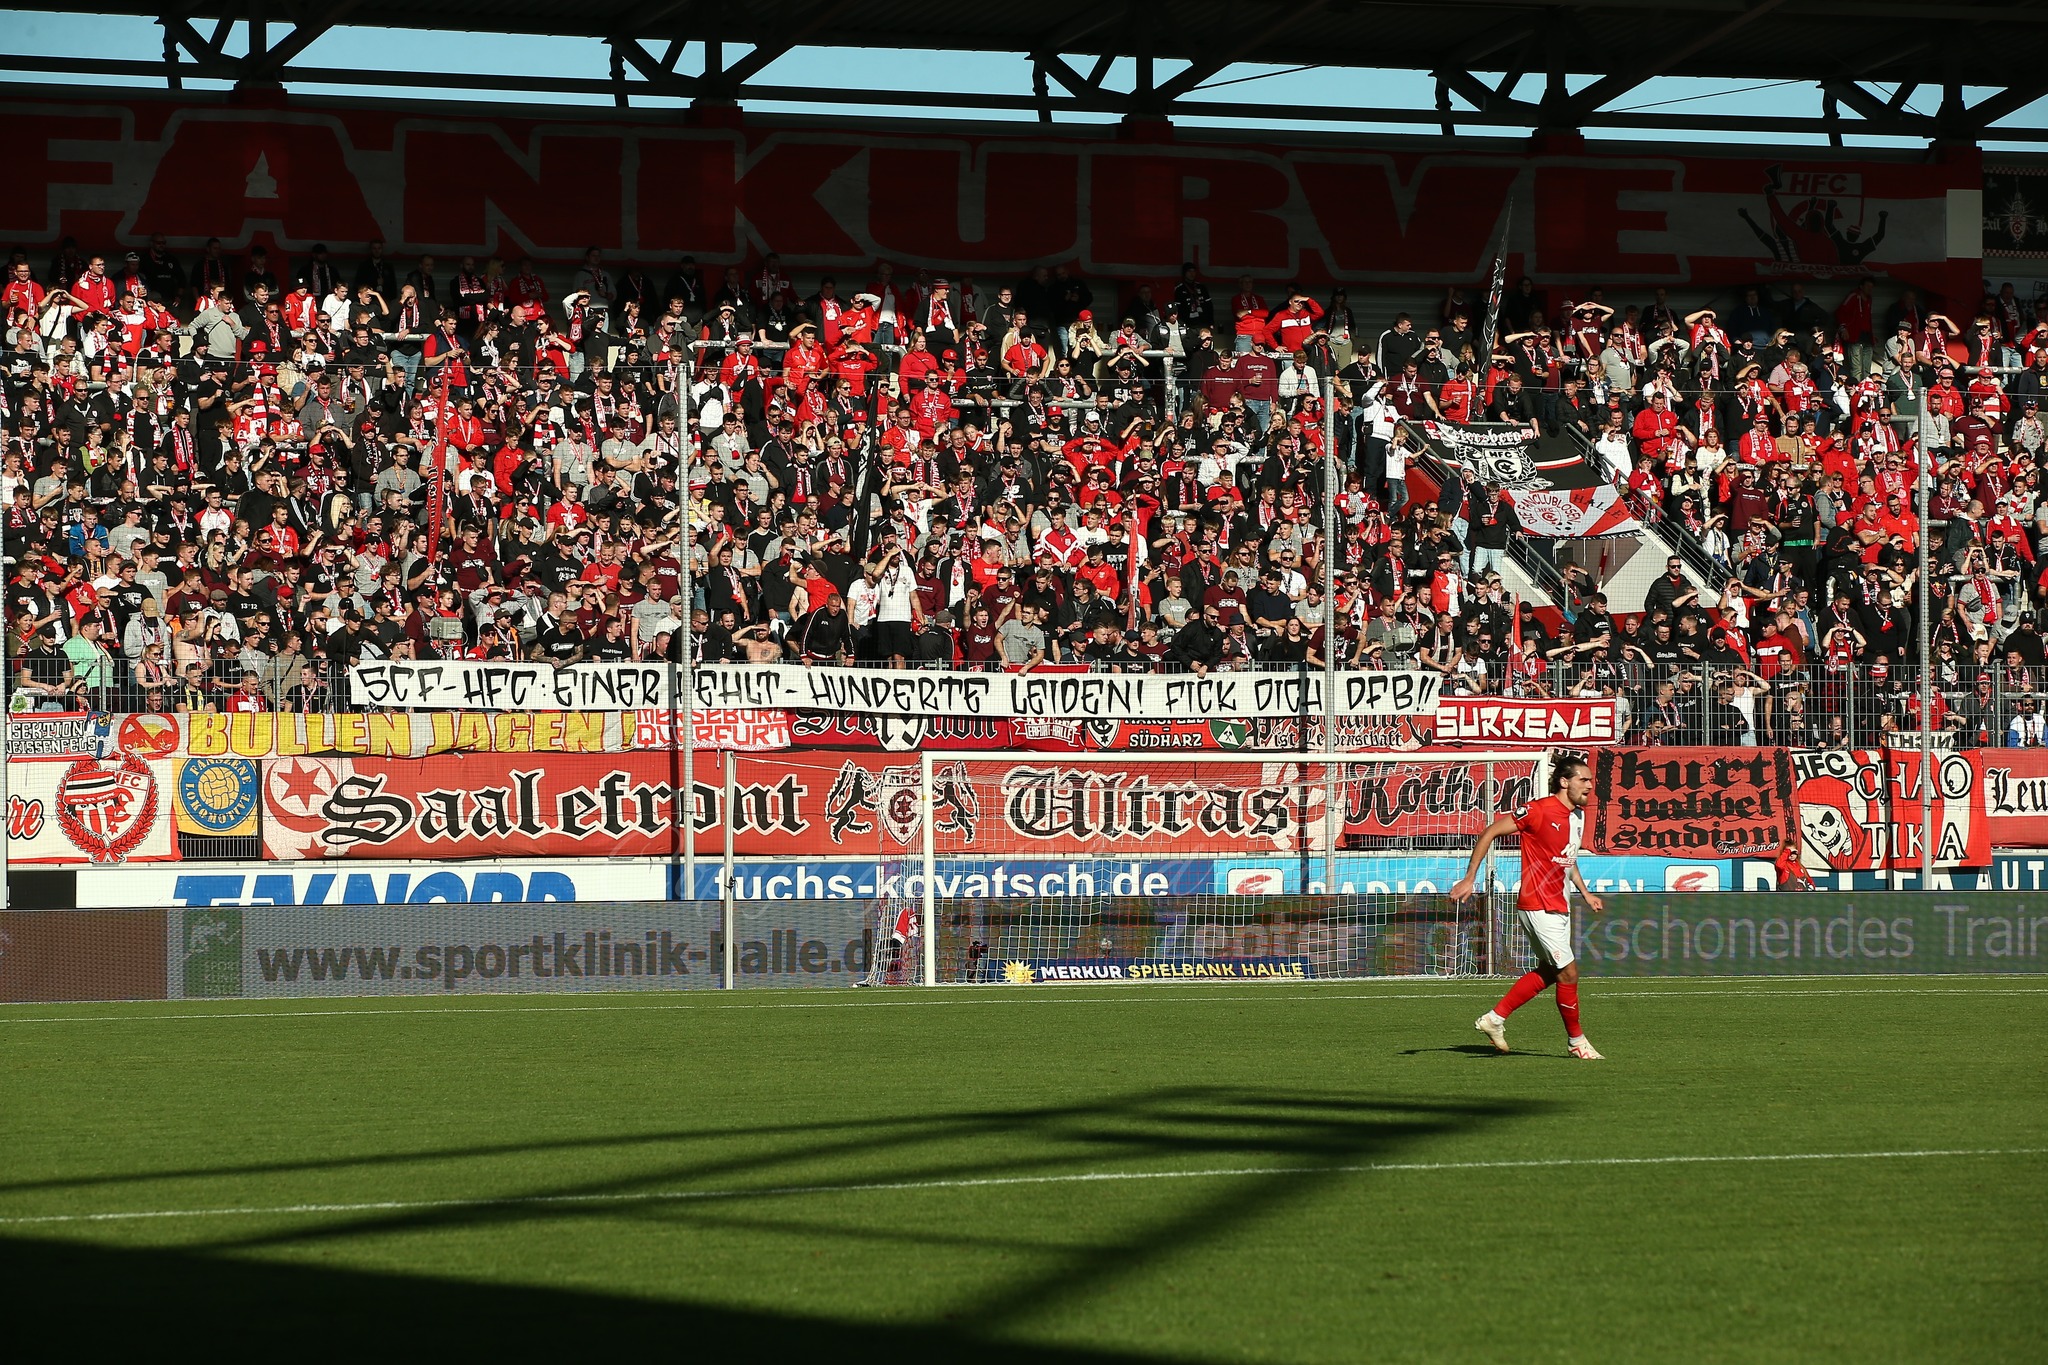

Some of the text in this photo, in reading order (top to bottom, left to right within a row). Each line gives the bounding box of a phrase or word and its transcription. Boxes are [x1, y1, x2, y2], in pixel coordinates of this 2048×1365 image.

[0, 102, 1690, 285] FANKURVE
[1790, 173, 1847, 194] HFC
[552, 667, 661, 706] EINER
[807, 671, 990, 714] HUNDERTE
[1010, 677, 1145, 715] LEIDEN!
[1166, 678, 1236, 714] FICK
[1347, 674, 1437, 713] DFB!!
[12, 721, 84, 740] SEKTION
[188, 712, 412, 758] BULLEN
[427, 710, 605, 757] JAGEN
[1436, 706, 1612, 739] SURREALE
[1129, 730, 1203, 747] SÜDHARZ
[1796, 753, 1847, 781] HFC
[1041, 961, 1304, 979] MERKUR SPIELBANK HALLE
